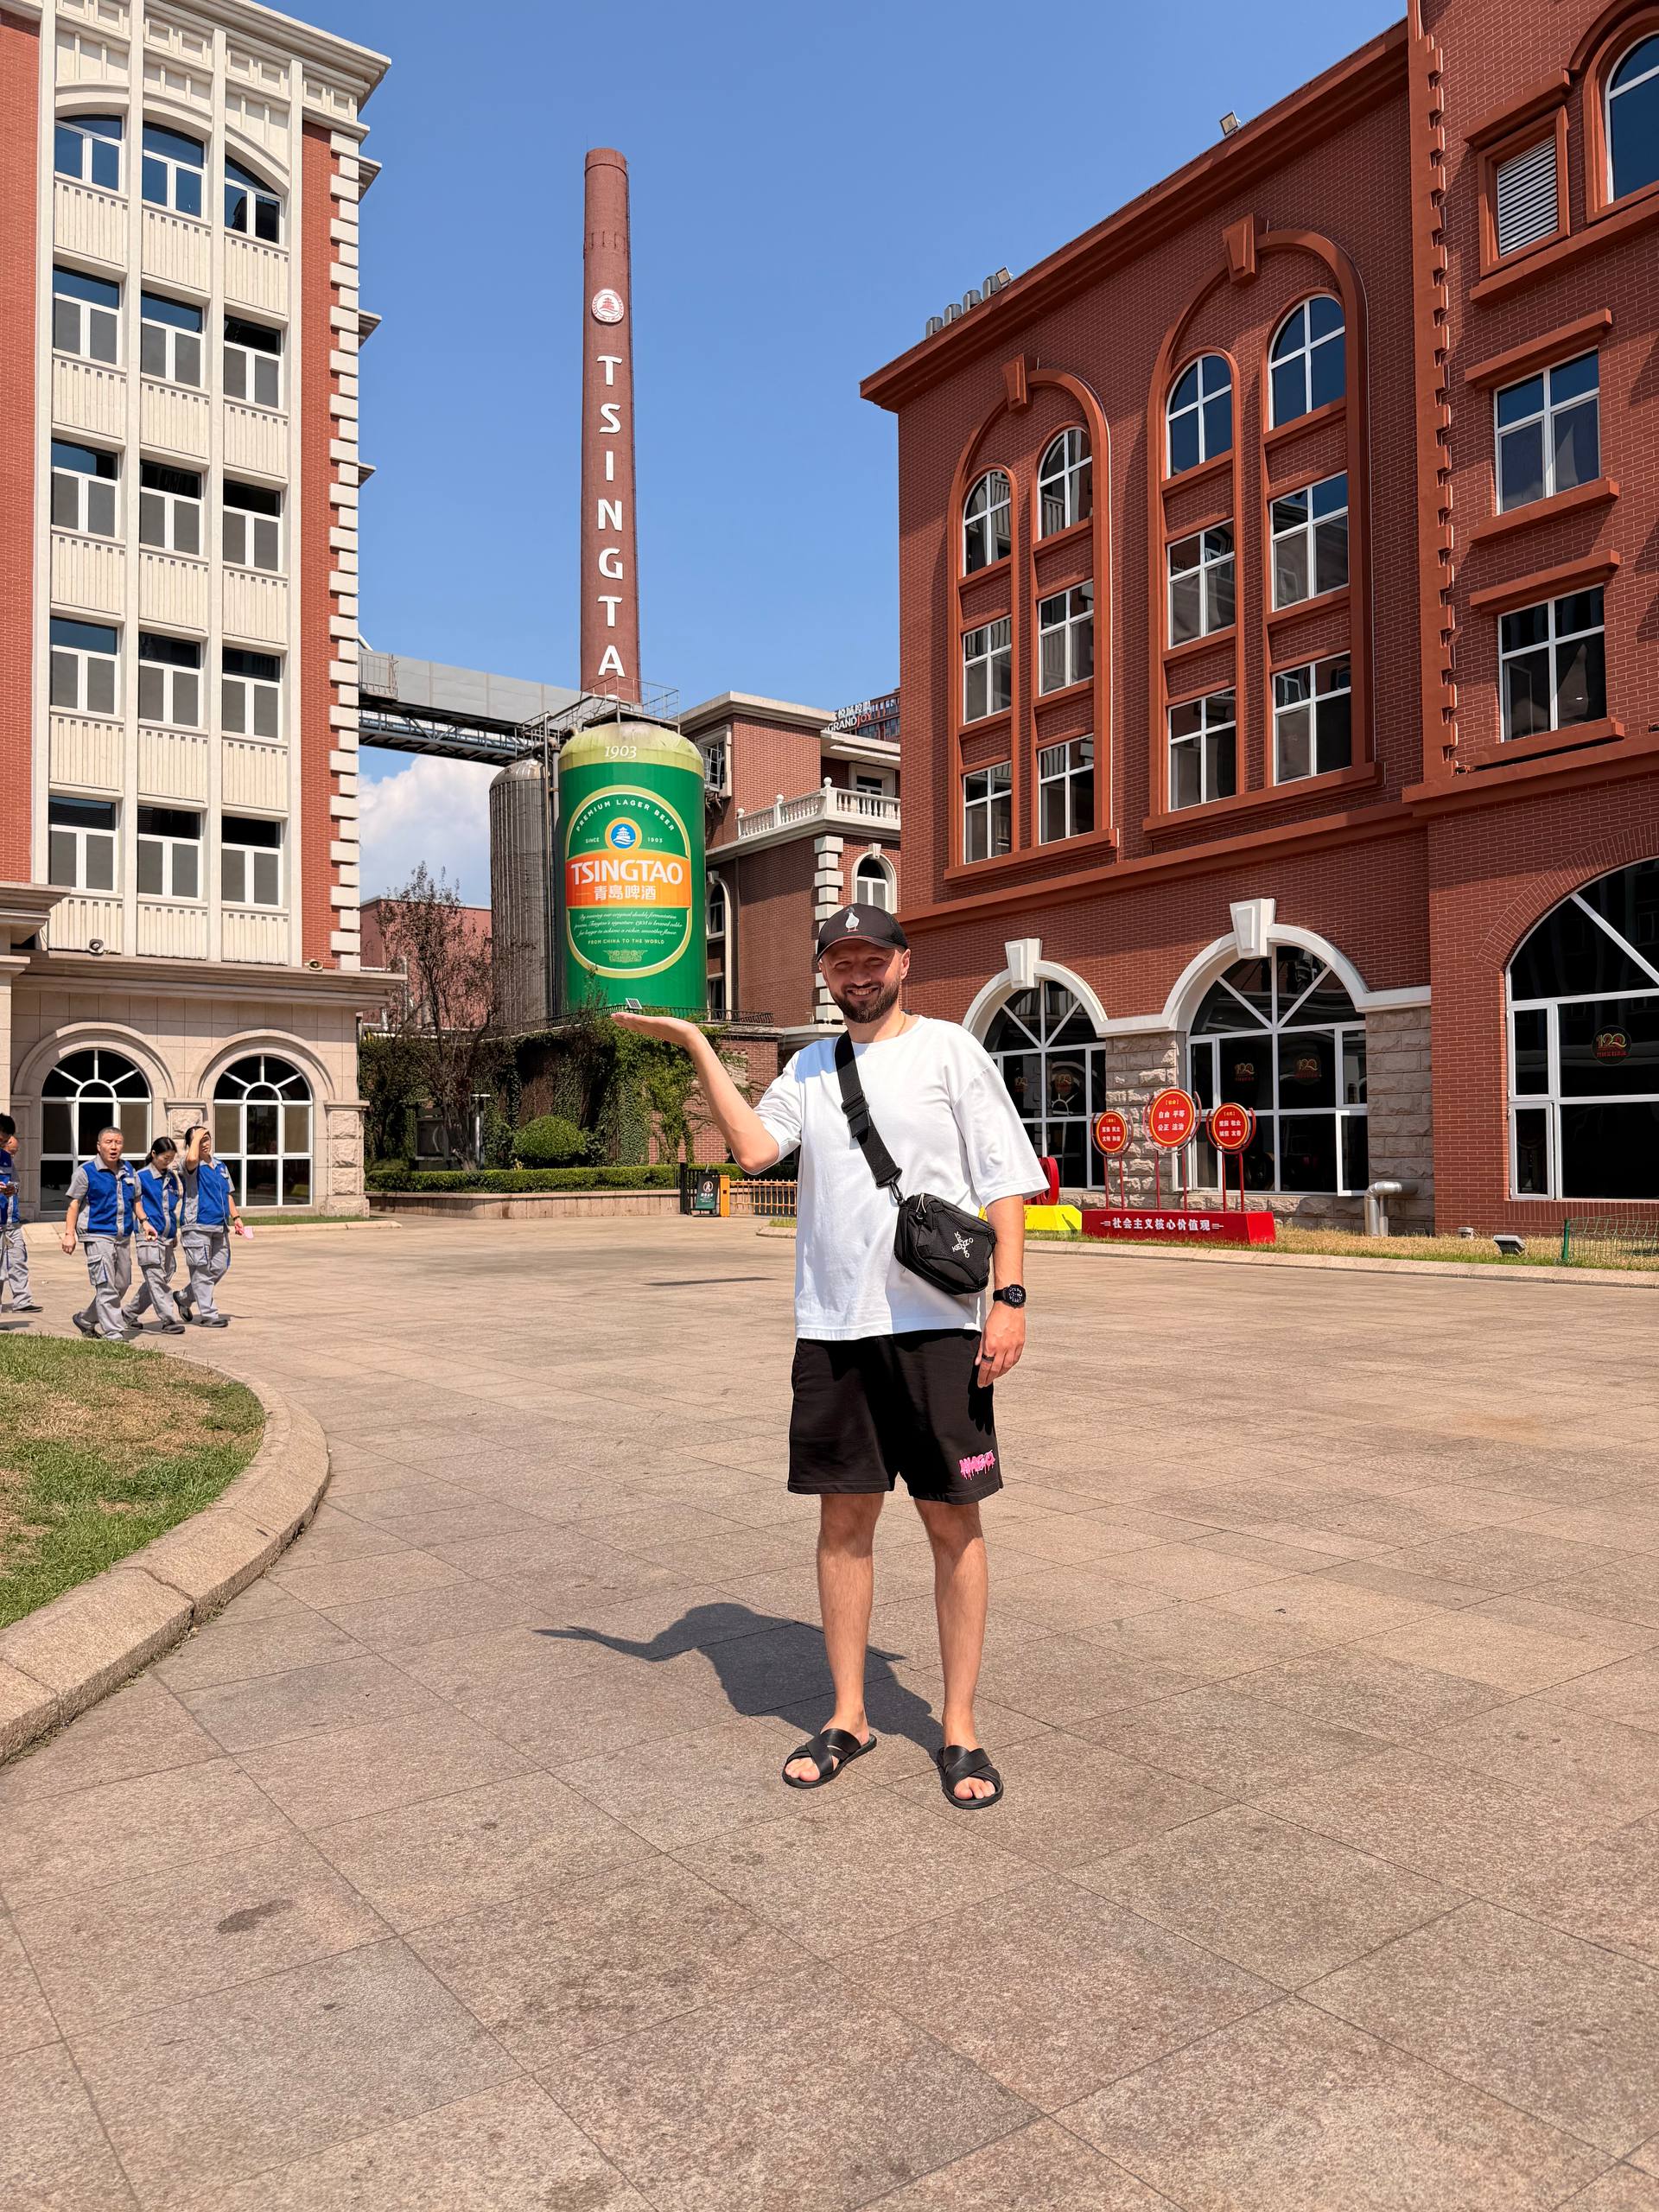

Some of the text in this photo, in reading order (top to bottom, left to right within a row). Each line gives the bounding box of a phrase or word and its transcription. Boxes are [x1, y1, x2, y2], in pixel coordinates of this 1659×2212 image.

[596, 355, 626, 699] TSINGTA
[605, 746, 637, 760] 1903
[575, 799, 675, 832] PREMIUM LAGER BEER
[570, 859, 683, 885] TSINGTAO
[594, 885, 657, 900] 青島啤酒
[1112, 1217, 1211, 1231] 社会主义核心价值观
[951, 1237, 974, 1252] KENZO
